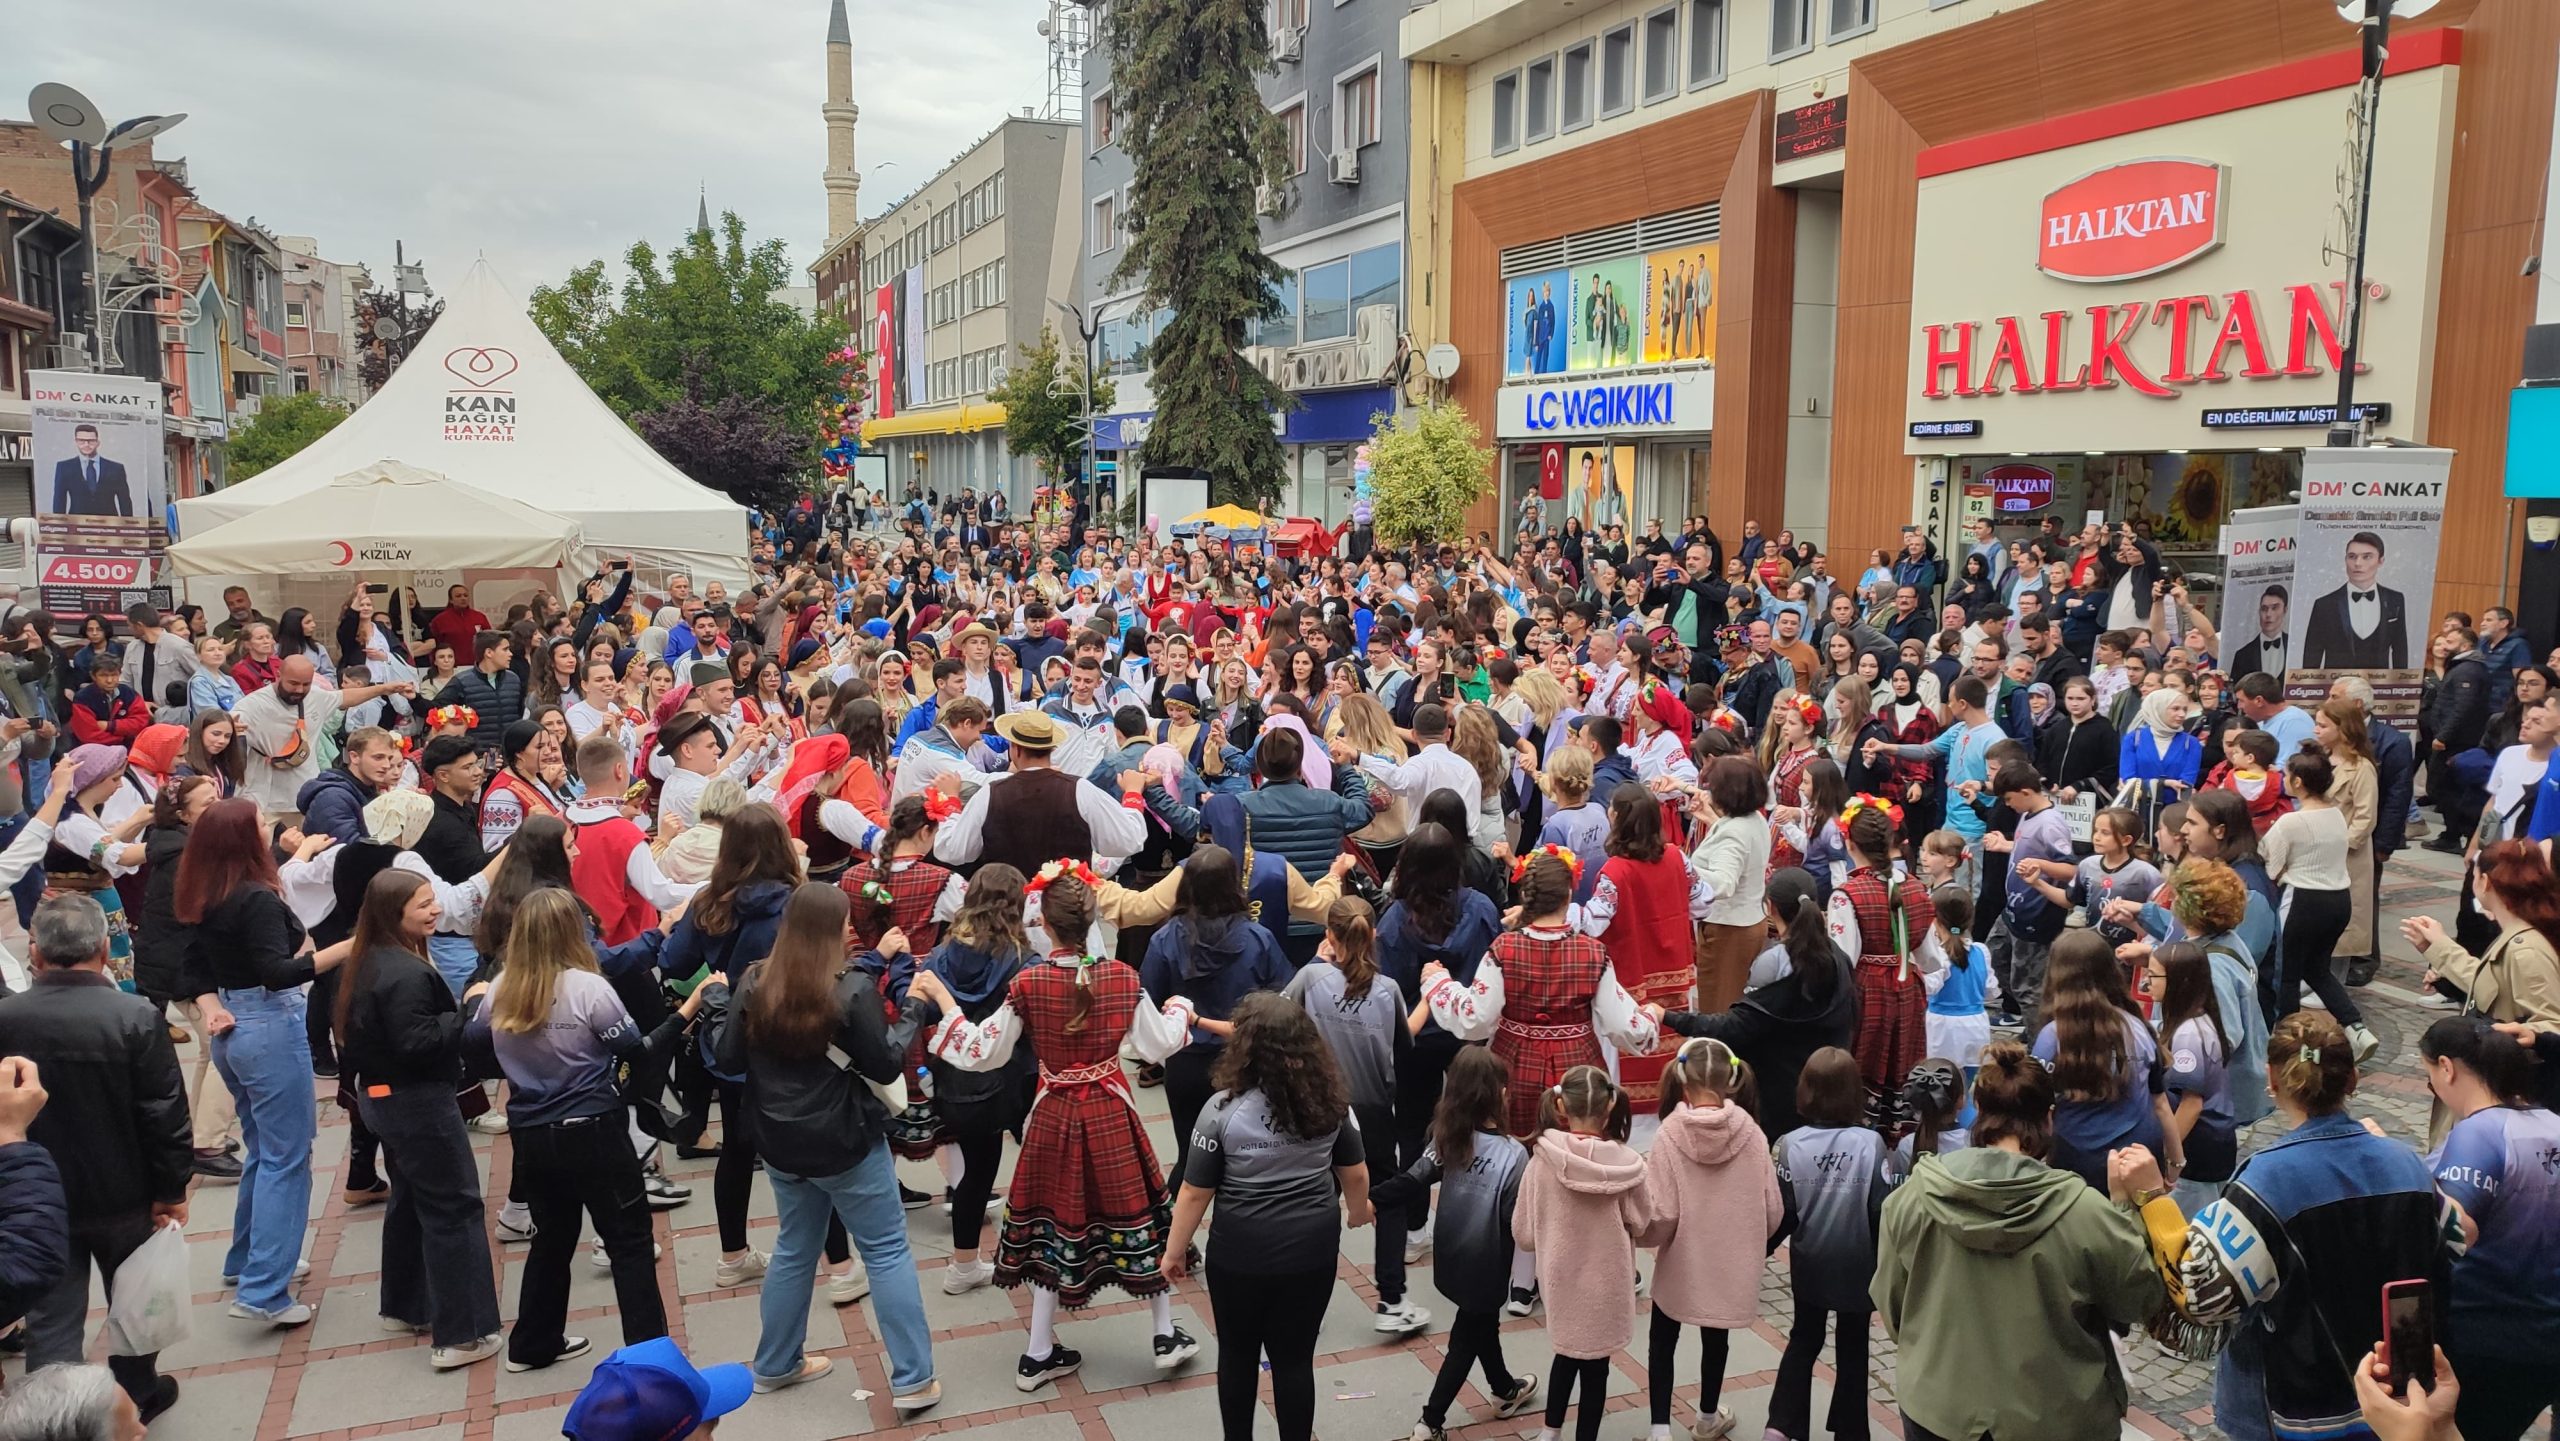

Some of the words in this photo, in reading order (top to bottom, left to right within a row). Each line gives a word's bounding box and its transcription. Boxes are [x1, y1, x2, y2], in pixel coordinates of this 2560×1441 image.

[2048, 191, 2207, 247] HALKTAN
[1922, 281, 2370, 398] HALKTAN
[70, 392, 140, 405] CANKAT
[446, 396, 516, 413] KAN
[1526, 390, 1557, 430] LC
[2207, 414, 2223, 424] EN
[2225, 408, 2296, 424] DEĞERLİMİZ
[445, 412, 516, 426] BAĞIŞI
[444, 425, 516, 435] HAYAT
[1913, 423, 1943, 435] EDİRNE
[1944, 421, 1974, 435] ŞUBESİ
[444, 434, 515, 442] KURTARIR
[2308, 482, 2347, 496] DM'
[2351, 482, 2442, 497] CANKAT
[1928, 488, 1940, 538] BAK
[374, 541, 398, 549] TÜRK
[2266, 537, 2297, 552] CAN
[360, 549, 412, 560] KIZILAY
